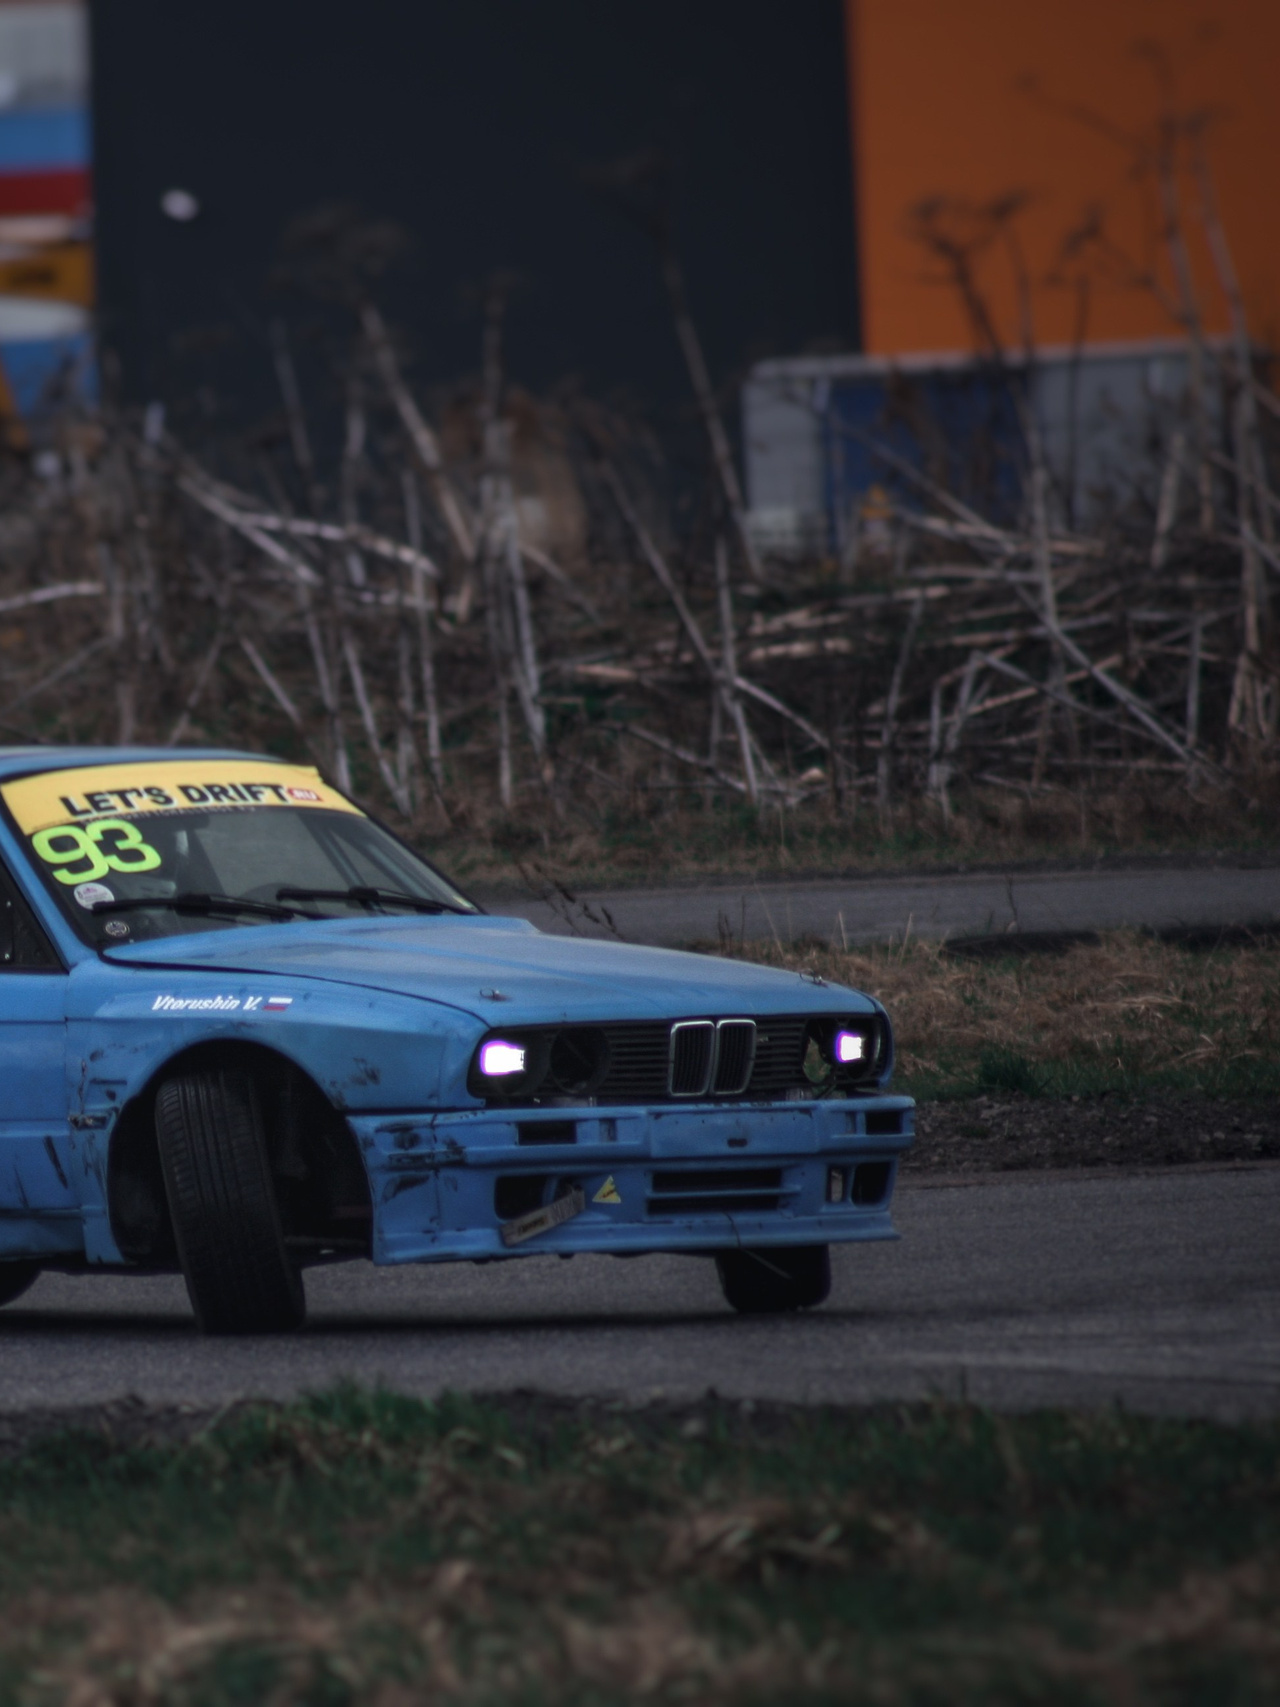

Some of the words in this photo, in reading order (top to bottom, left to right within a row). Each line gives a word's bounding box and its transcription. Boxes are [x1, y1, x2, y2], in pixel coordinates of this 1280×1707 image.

[59, 786, 176, 817] LET'S
[177, 783, 290, 804] DRIFT
[32, 819, 161, 885] 93
[152, 995, 240, 1011] Vtorushin
[242, 996, 263, 1011] V.
